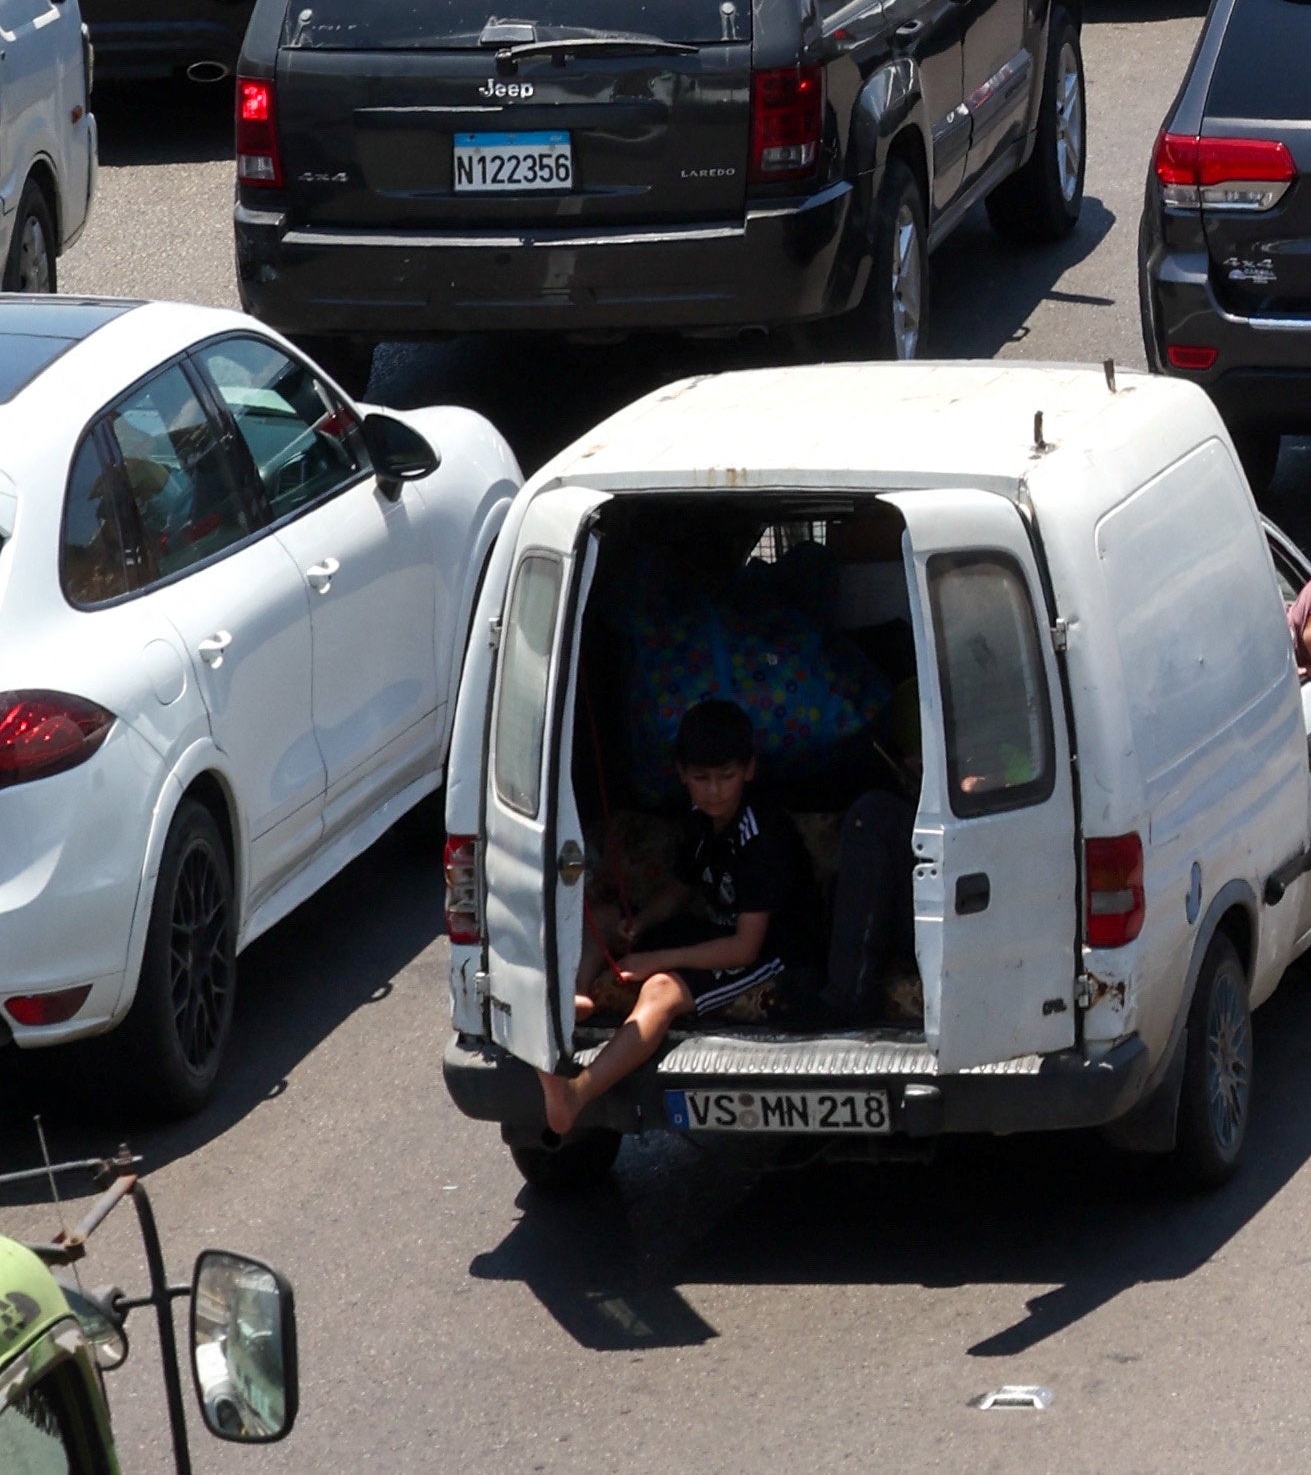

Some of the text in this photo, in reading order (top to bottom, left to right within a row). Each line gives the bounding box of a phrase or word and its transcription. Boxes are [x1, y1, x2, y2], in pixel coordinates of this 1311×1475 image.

[478, 78, 535, 99] Jeep
[457, 154, 571, 187] N122356
[681, 168, 736, 178] LAREDO
[689, 1093, 887, 1129] VS MN 218
